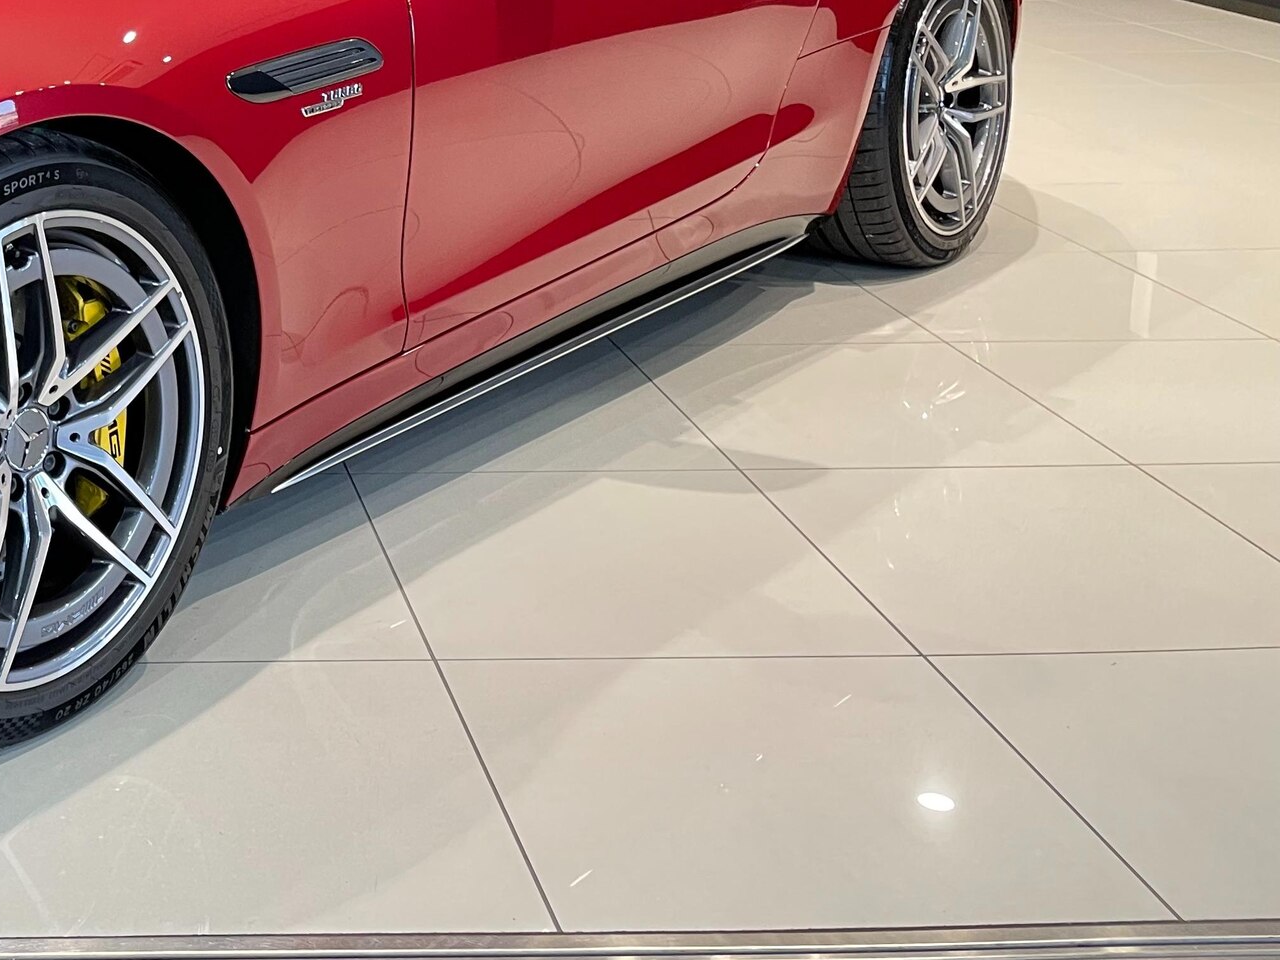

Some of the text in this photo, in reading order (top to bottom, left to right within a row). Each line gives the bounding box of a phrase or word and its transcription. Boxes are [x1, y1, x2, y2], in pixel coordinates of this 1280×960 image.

[3, 171, 45, 197] SPORT
[53, 169, 61, 181] S
[54, 704, 72, 722] 20
